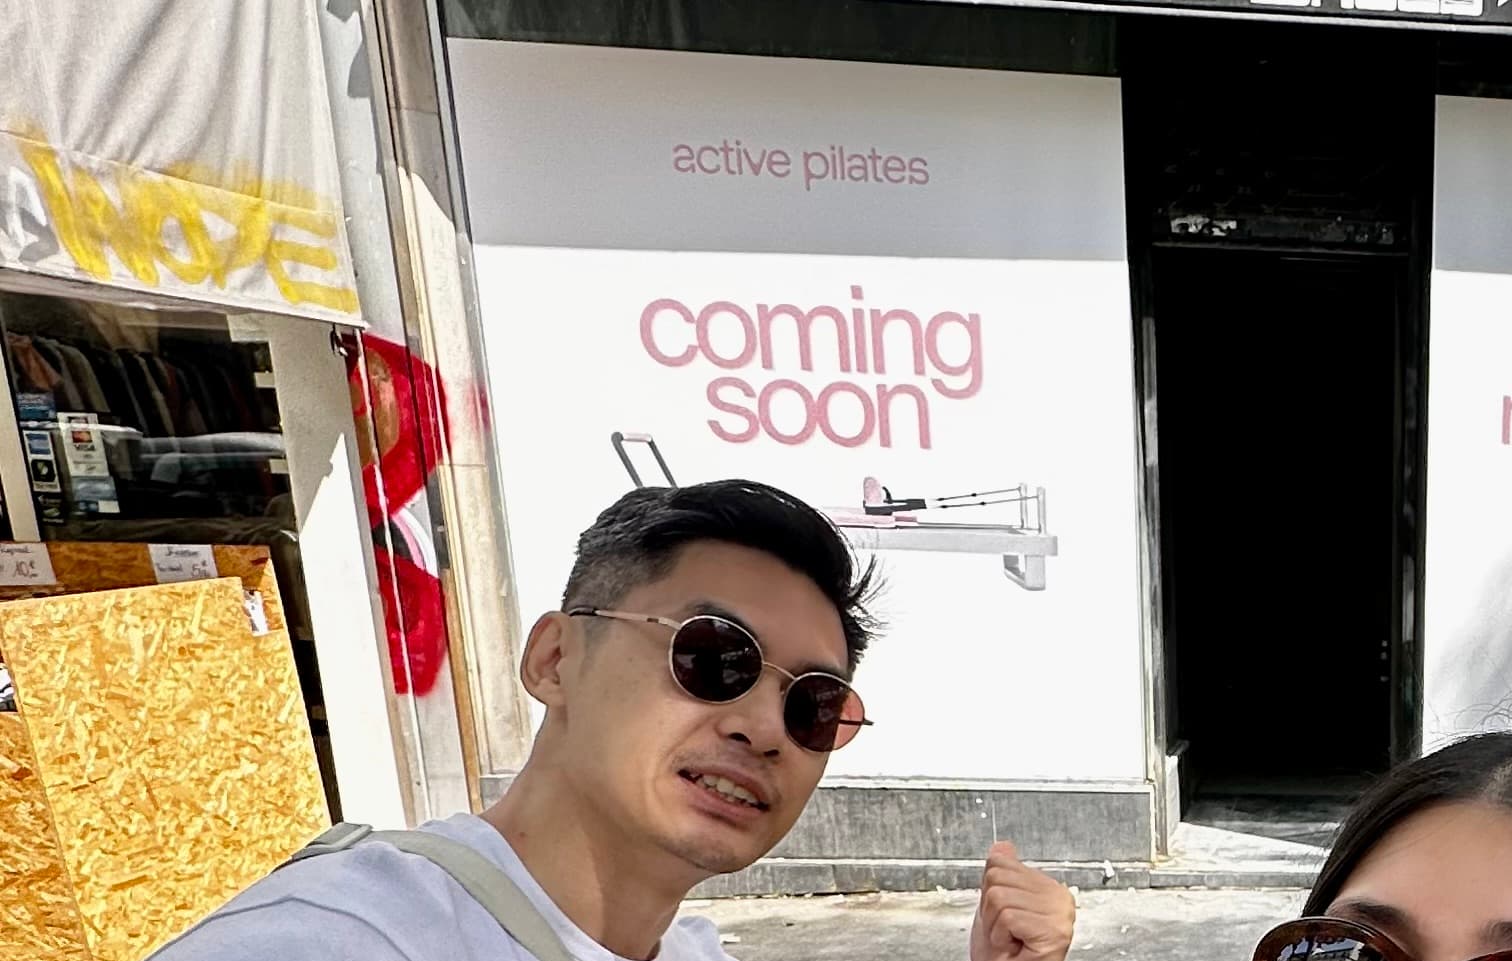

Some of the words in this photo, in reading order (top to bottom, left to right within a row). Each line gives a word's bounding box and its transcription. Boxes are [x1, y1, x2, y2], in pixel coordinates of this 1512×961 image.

[672, 140, 791, 178] active
[802, 145, 930, 191] pilates
[639, 285, 983, 400] coming
[705, 376, 932, 450] soon
